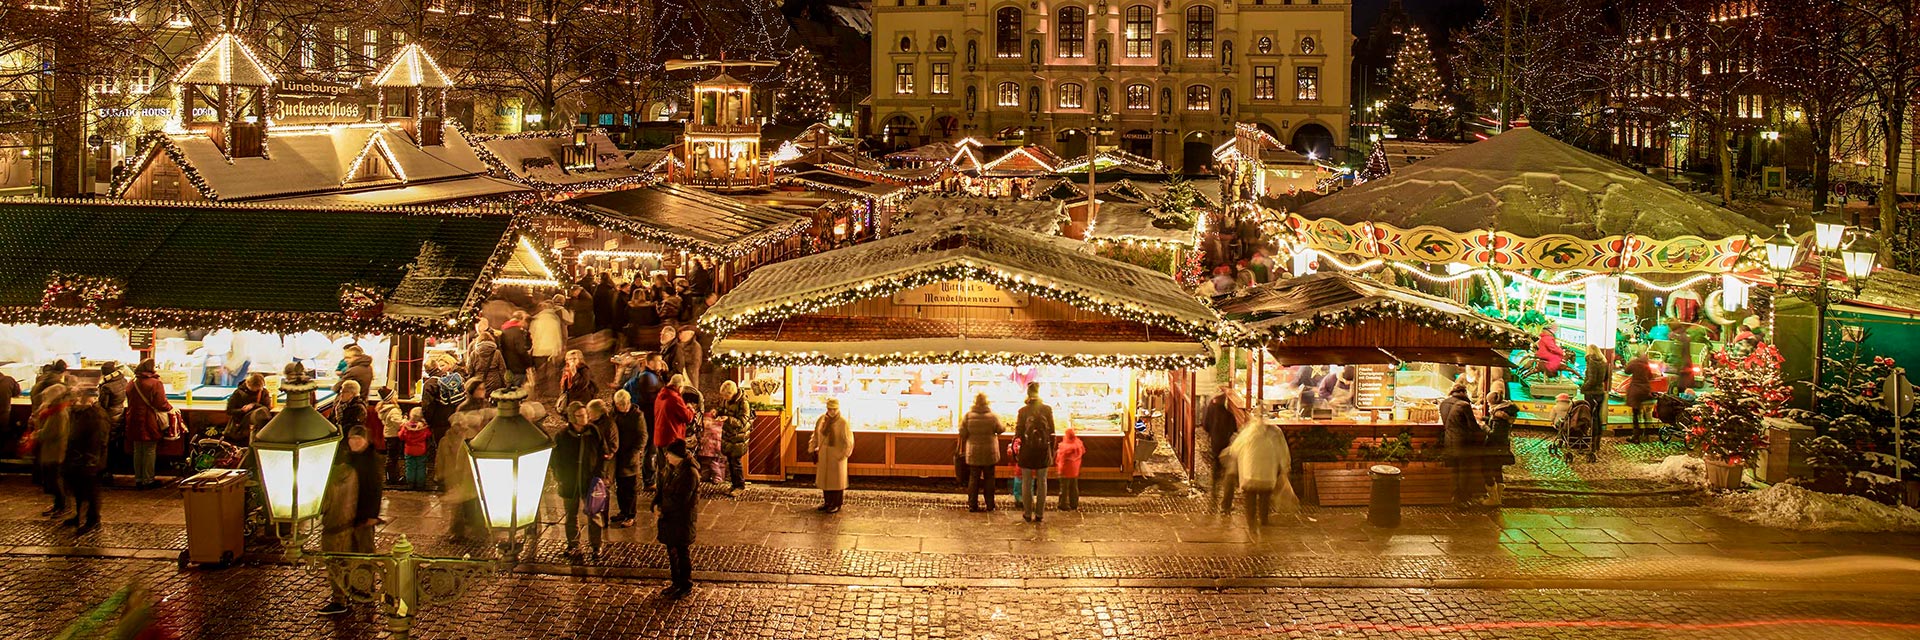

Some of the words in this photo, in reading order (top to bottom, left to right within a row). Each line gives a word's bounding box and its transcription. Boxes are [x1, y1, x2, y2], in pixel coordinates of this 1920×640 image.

[282, 80, 350, 96] Lüneburger
[141, 108, 171, 117] HOUSE
[274, 99, 359, 121] Zuckerschloss
[924, 293, 1000, 302] Mandelbrennerei
